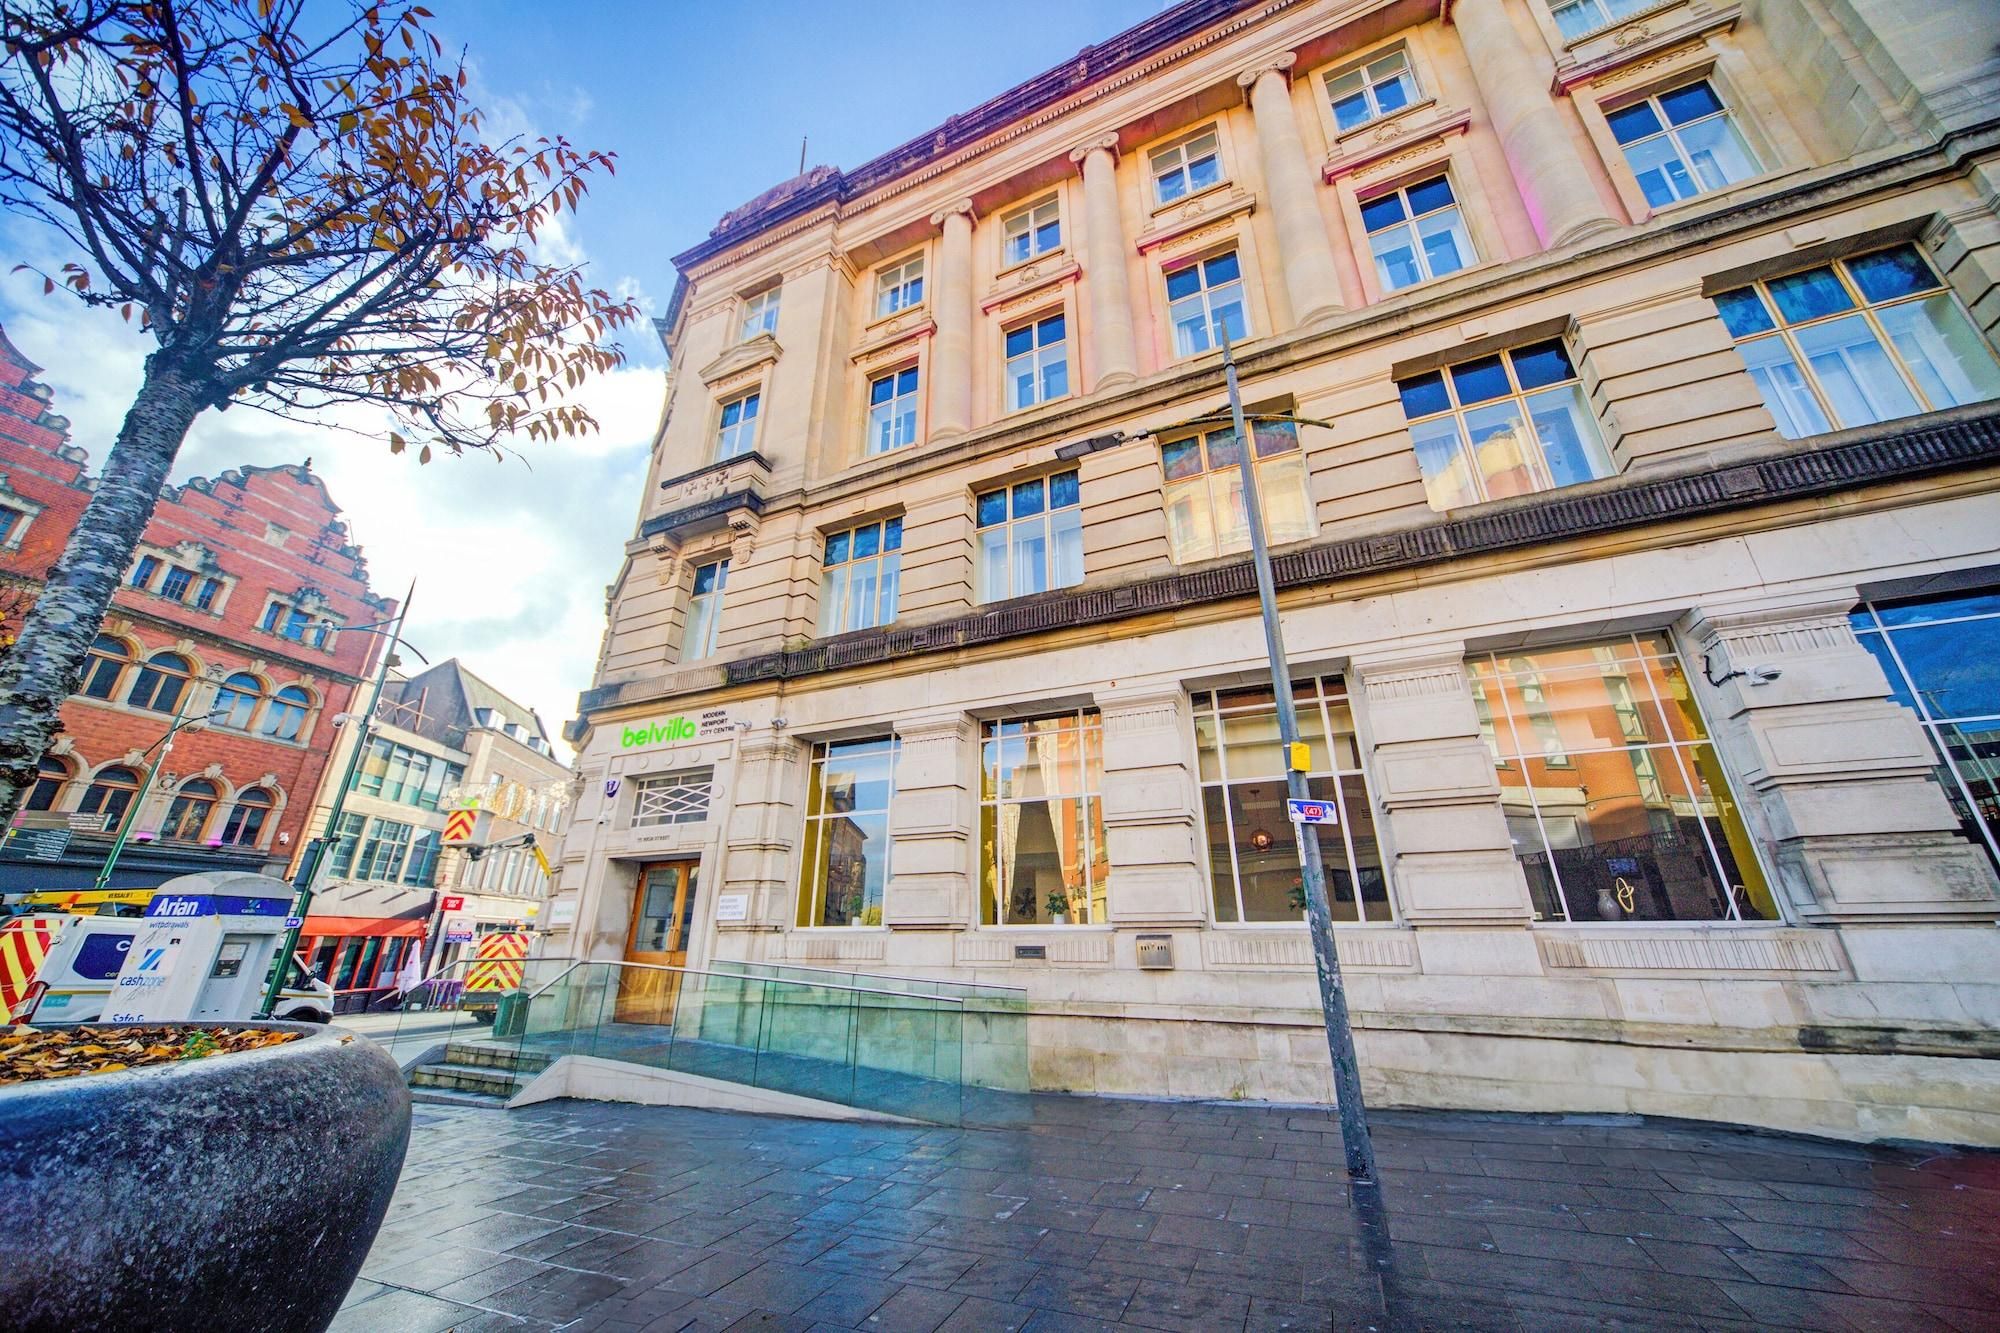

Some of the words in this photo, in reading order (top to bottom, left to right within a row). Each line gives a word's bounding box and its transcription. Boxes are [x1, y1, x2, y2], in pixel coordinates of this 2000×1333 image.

[702, 710, 727, 719] MODERN
[702, 718, 728, 727] NEWPORT
[713, 725, 735, 734] CENTRE
[153, 897, 199, 916] Arian
